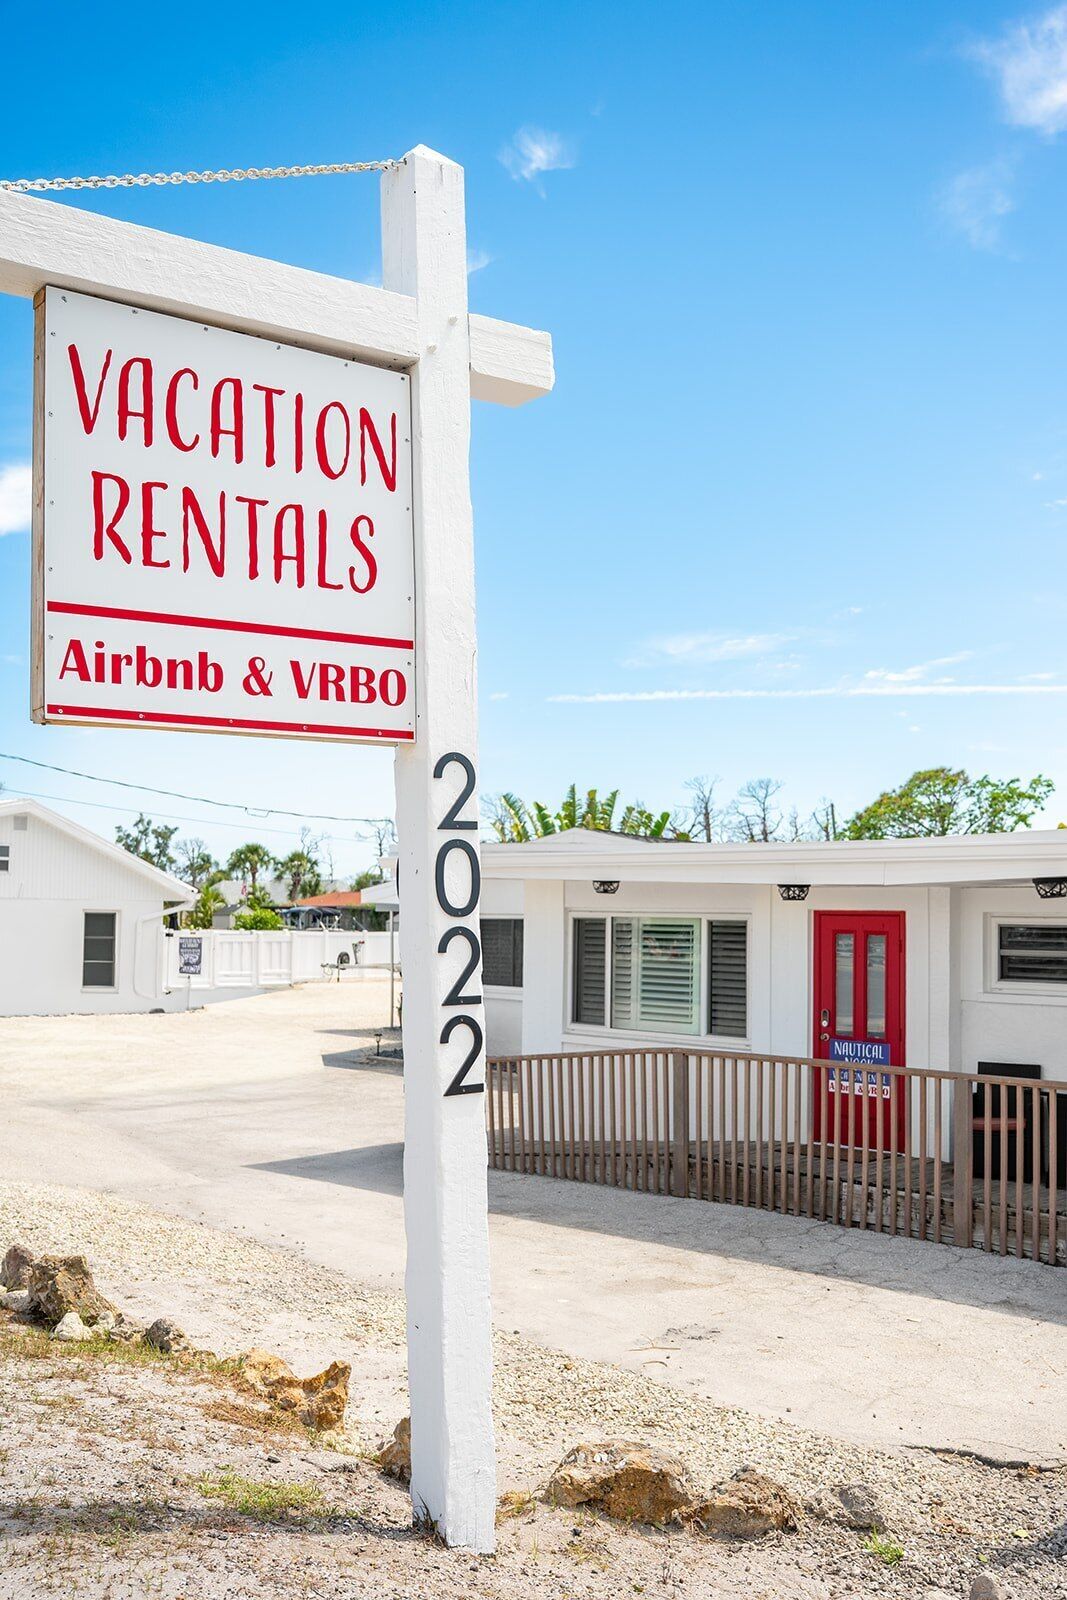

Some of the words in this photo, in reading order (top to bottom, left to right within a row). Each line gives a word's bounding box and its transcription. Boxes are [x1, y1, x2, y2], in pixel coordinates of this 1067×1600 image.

[68, 344, 397, 493] VACATION
[91, 470, 378, 594] RENTALS
[59, 639, 224, 692] Airbnb
[242, 656, 273, 697] &
[290, 660, 407, 707] VRBO
[434, 752, 485, 1097] 2022
[834, 1041, 884, 1059] NAUTICAL
